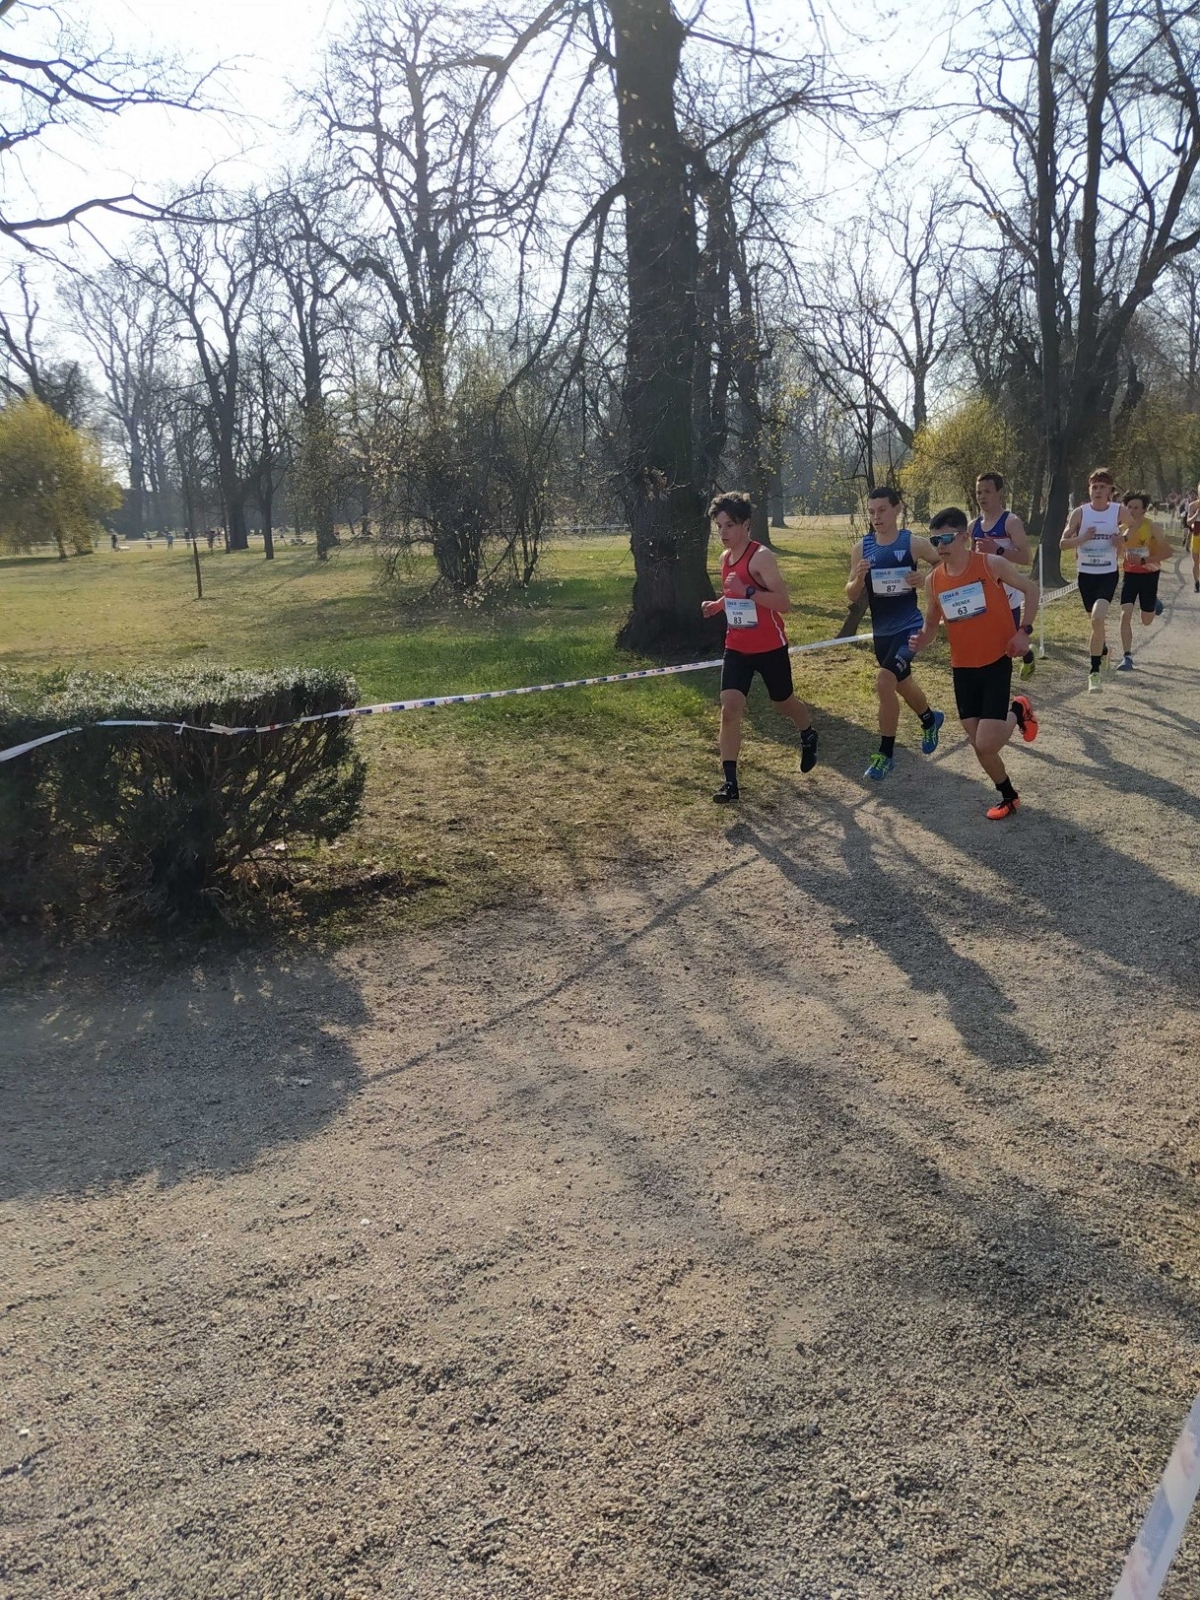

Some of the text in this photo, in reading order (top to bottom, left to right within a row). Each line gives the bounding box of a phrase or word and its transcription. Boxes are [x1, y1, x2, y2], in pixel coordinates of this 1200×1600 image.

[886, 585, 897, 593] 87
[957, 606, 968, 616] 63
[733, 616, 742, 624] 83
